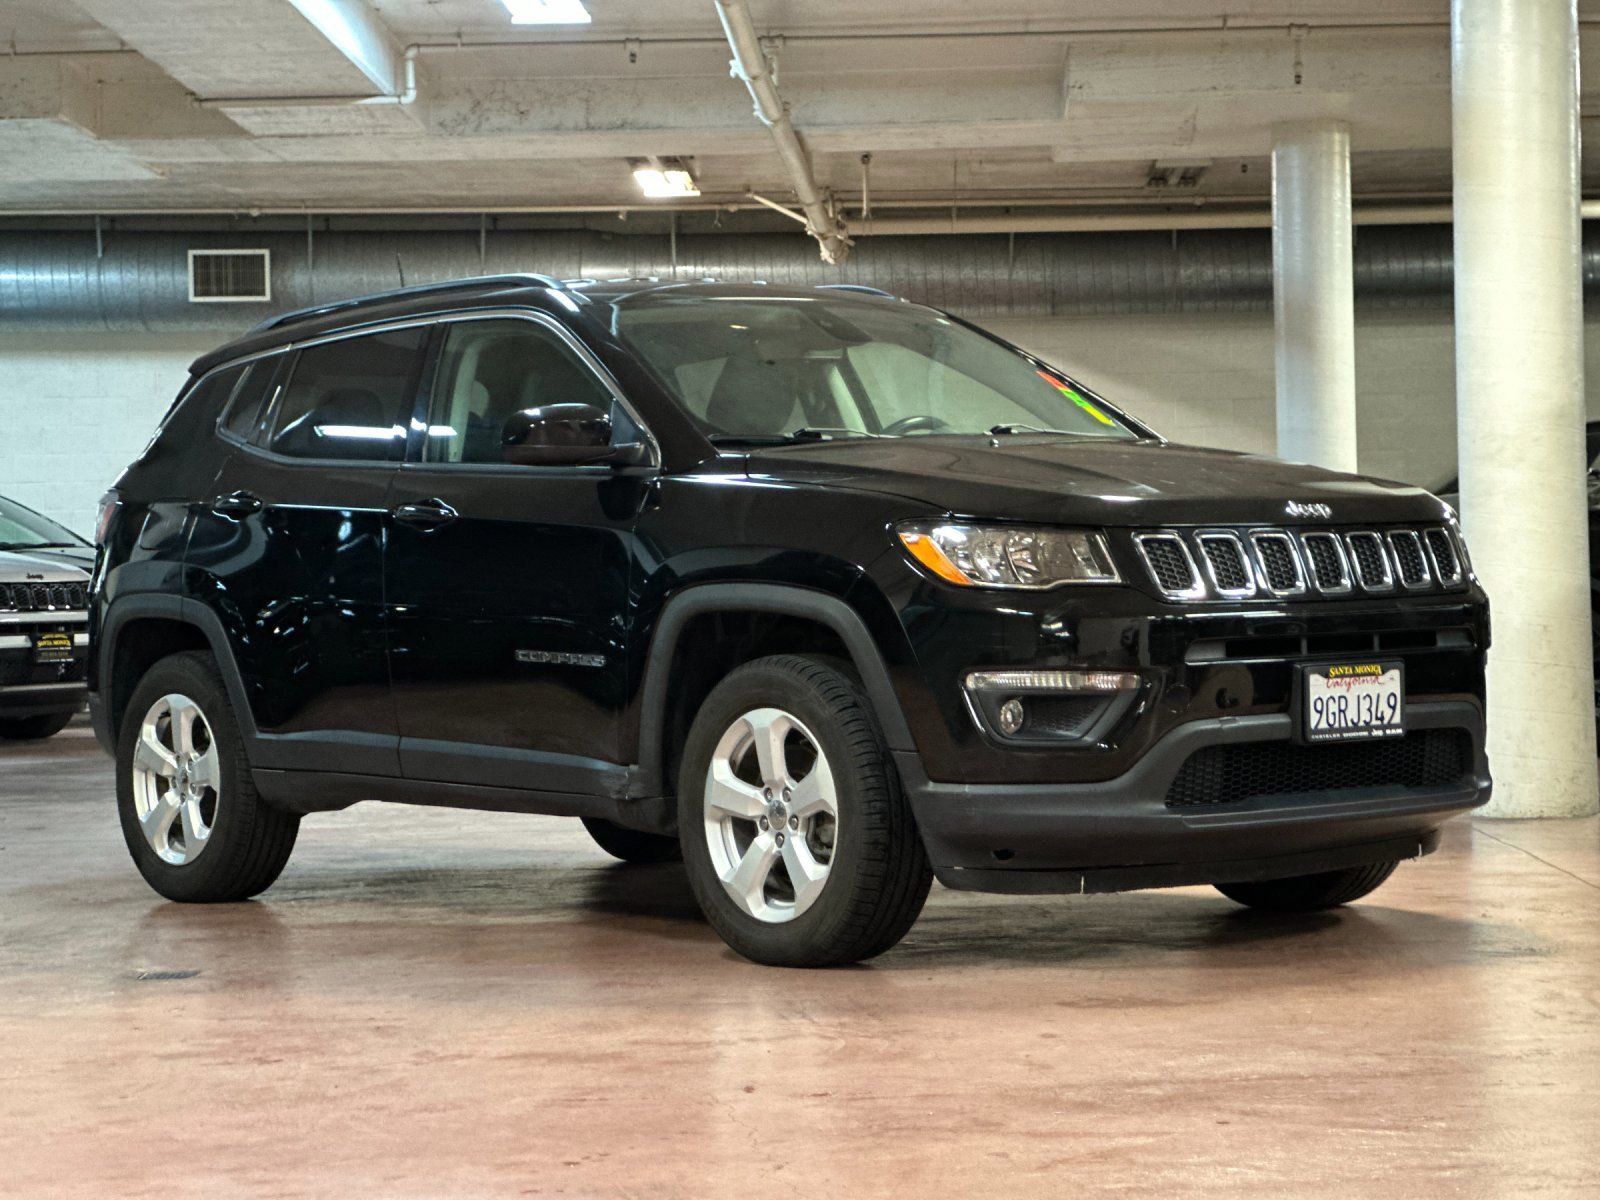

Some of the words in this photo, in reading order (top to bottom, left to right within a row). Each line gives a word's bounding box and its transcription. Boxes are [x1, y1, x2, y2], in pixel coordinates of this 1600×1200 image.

[1285, 500, 1332, 518] Jeep
[515, 649, 606, 667] COMPASS
[1329, 666, 1353, 677] SANTA
[1354, 664, 1382, 675] MONICA
[1327, 676, 1384, 692] California
[1313, 692, 1398, 731] 9GRJ349
